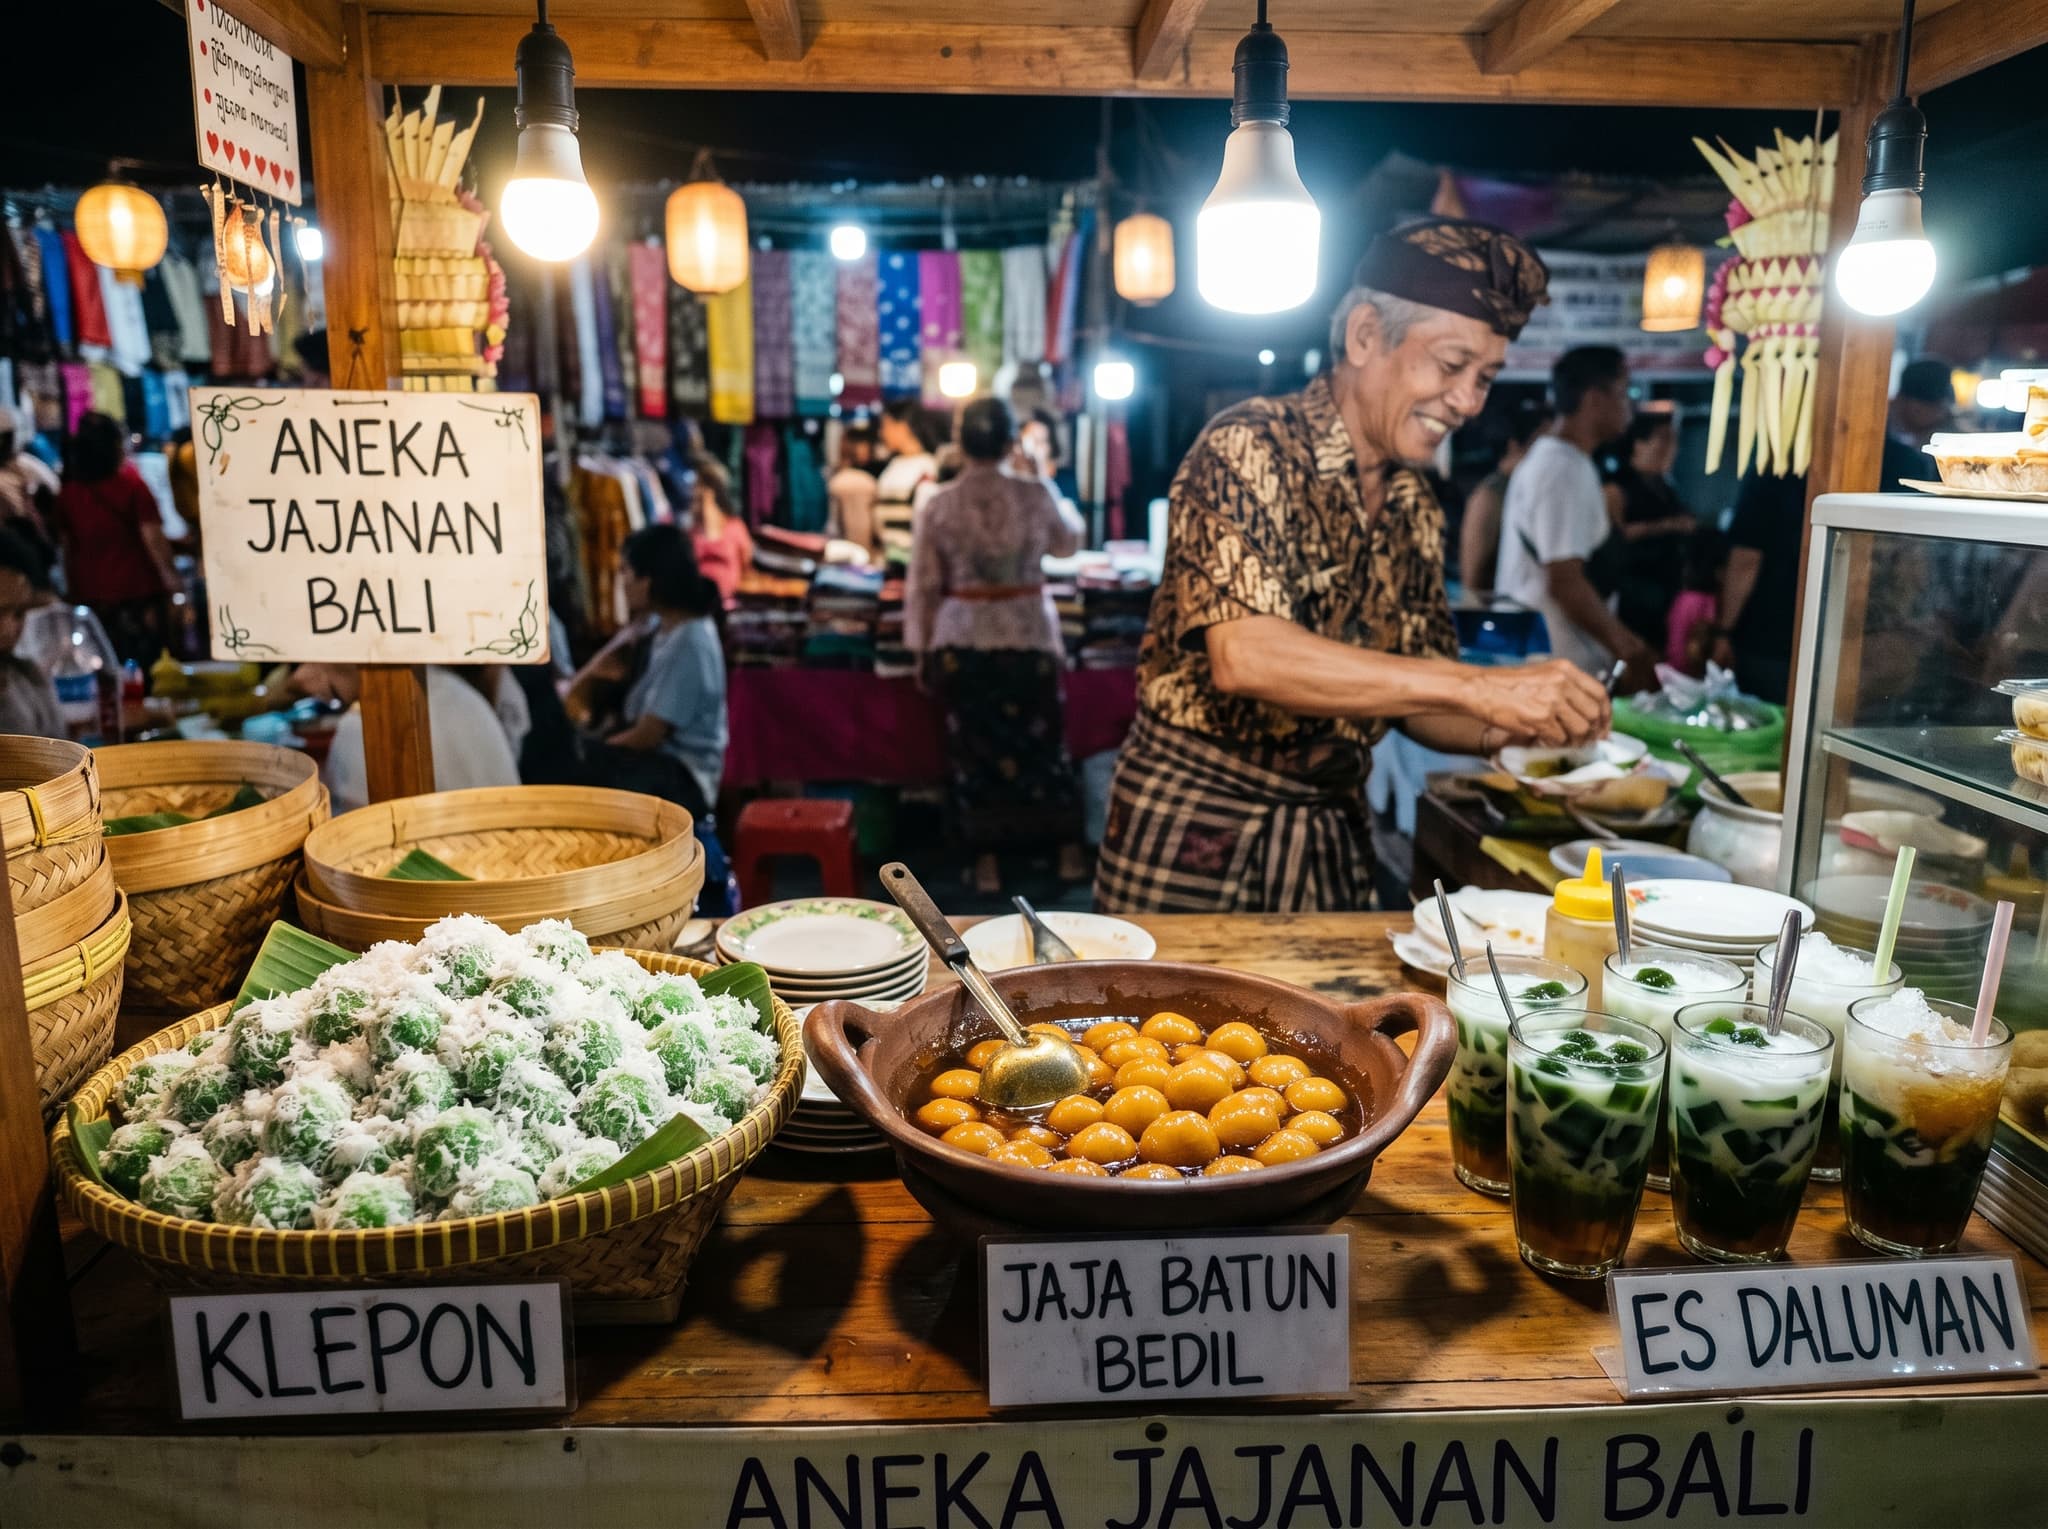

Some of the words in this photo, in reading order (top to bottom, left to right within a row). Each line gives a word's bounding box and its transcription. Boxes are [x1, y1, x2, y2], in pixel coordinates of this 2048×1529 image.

[270, 418, 470, 478] ANEKA
[247, 499, 502, 554] JAJANAN
[307, 577, 436, 634] BALI
[1002, 1259, 1133, 1323] JAJA
[1161, 1252, 1336, 1316] BATUN
[196, 1300, 536, 1404] KLEPON
[1632, 1289, 1717, 1375] ES
[1737, 1273, 2015, 1368] DALUMAN
[1095, 1331, 1264, 1393] BEDIL
[725, 1451, 1066, 1529] ANEKA
[1105, 1440, 1559, 1529] JAJANAN
[1604, 1428, 1814, 1522] BALI
